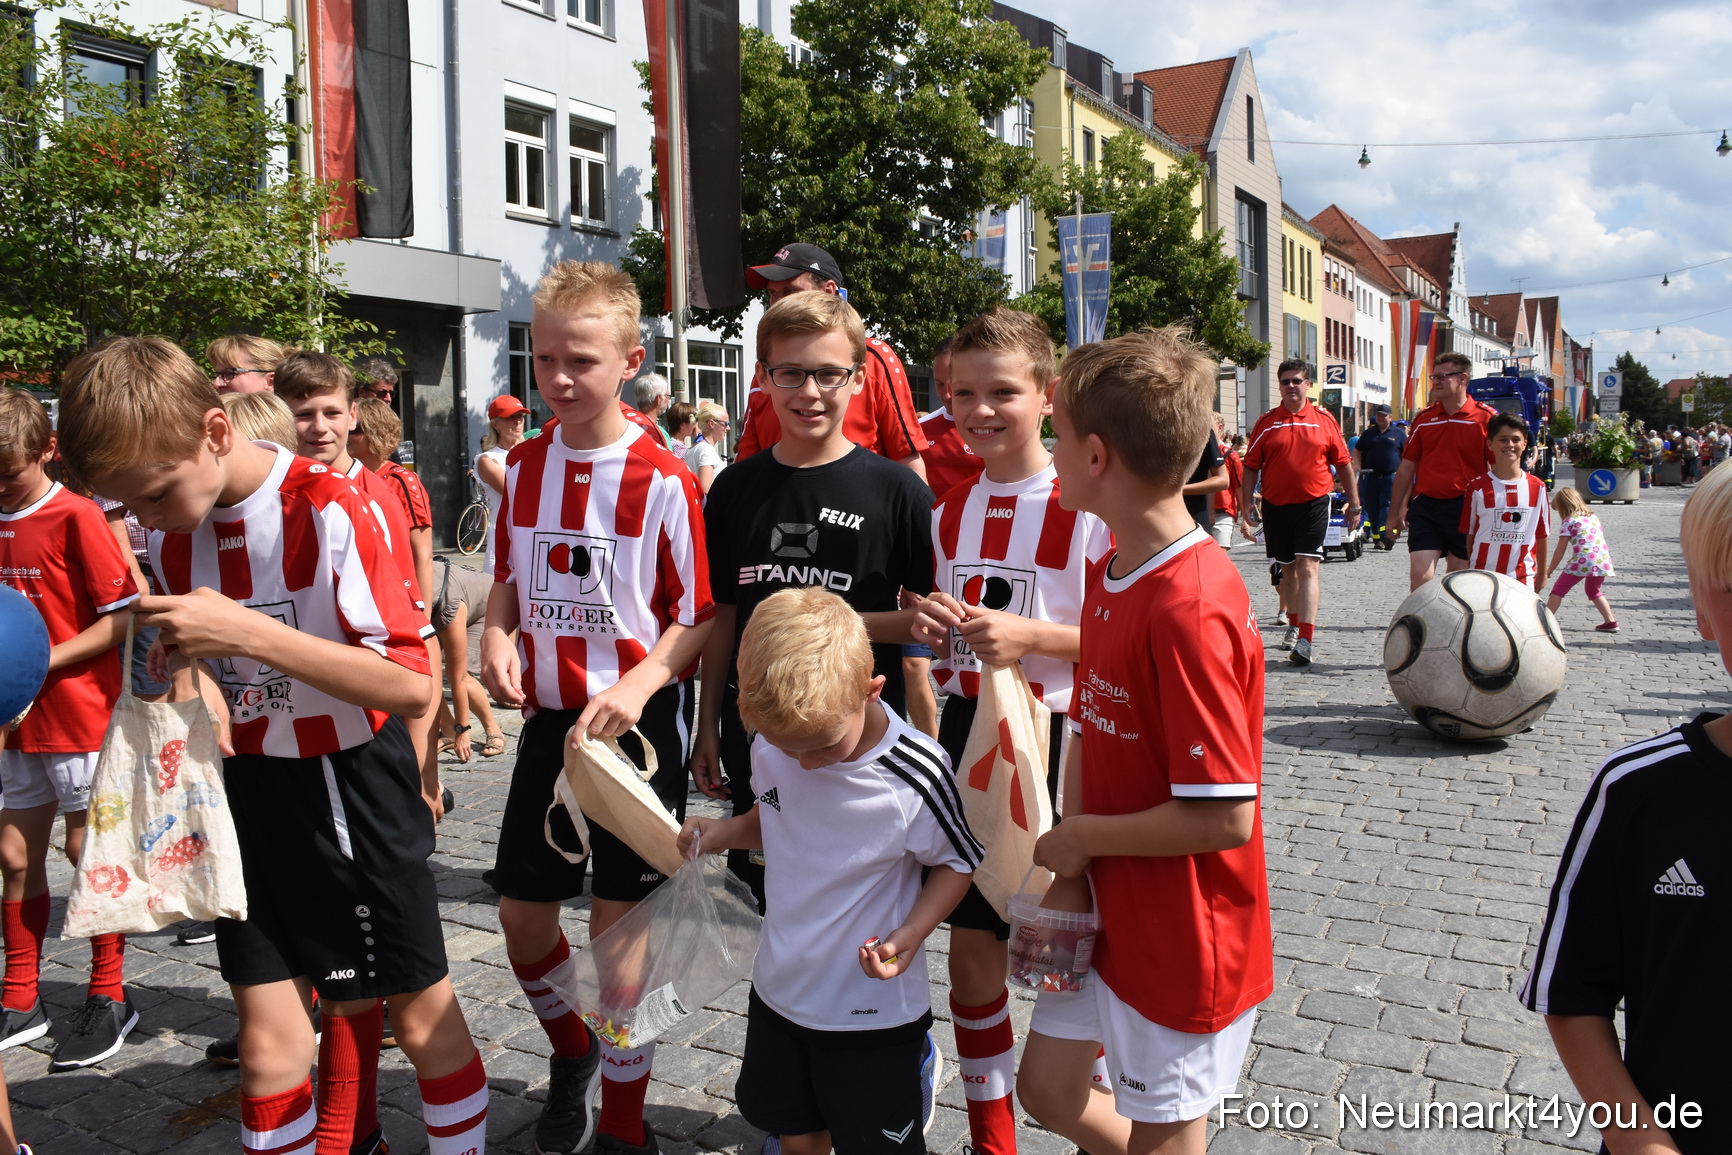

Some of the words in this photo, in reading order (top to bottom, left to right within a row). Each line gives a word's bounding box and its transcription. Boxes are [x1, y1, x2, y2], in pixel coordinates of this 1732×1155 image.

[575, 473, 591, 484] KO
[819, 507, 865, 530] FELIX
[986, 508, 1014, 519] JAKO
[219, 535, 245, 551] JAKO
[1491, 532, 1525, 540] POLGER
[738, 564, 853, 592] STANNO
[528, 603, 616, 625] POLGER
[528, 620, 618, 634] TRANSPORT
[640, 872, 659, 882] AKO
[1653, 882, 1705, 897] adidas
[1127, 1077, 1146, 1092] JAKO
